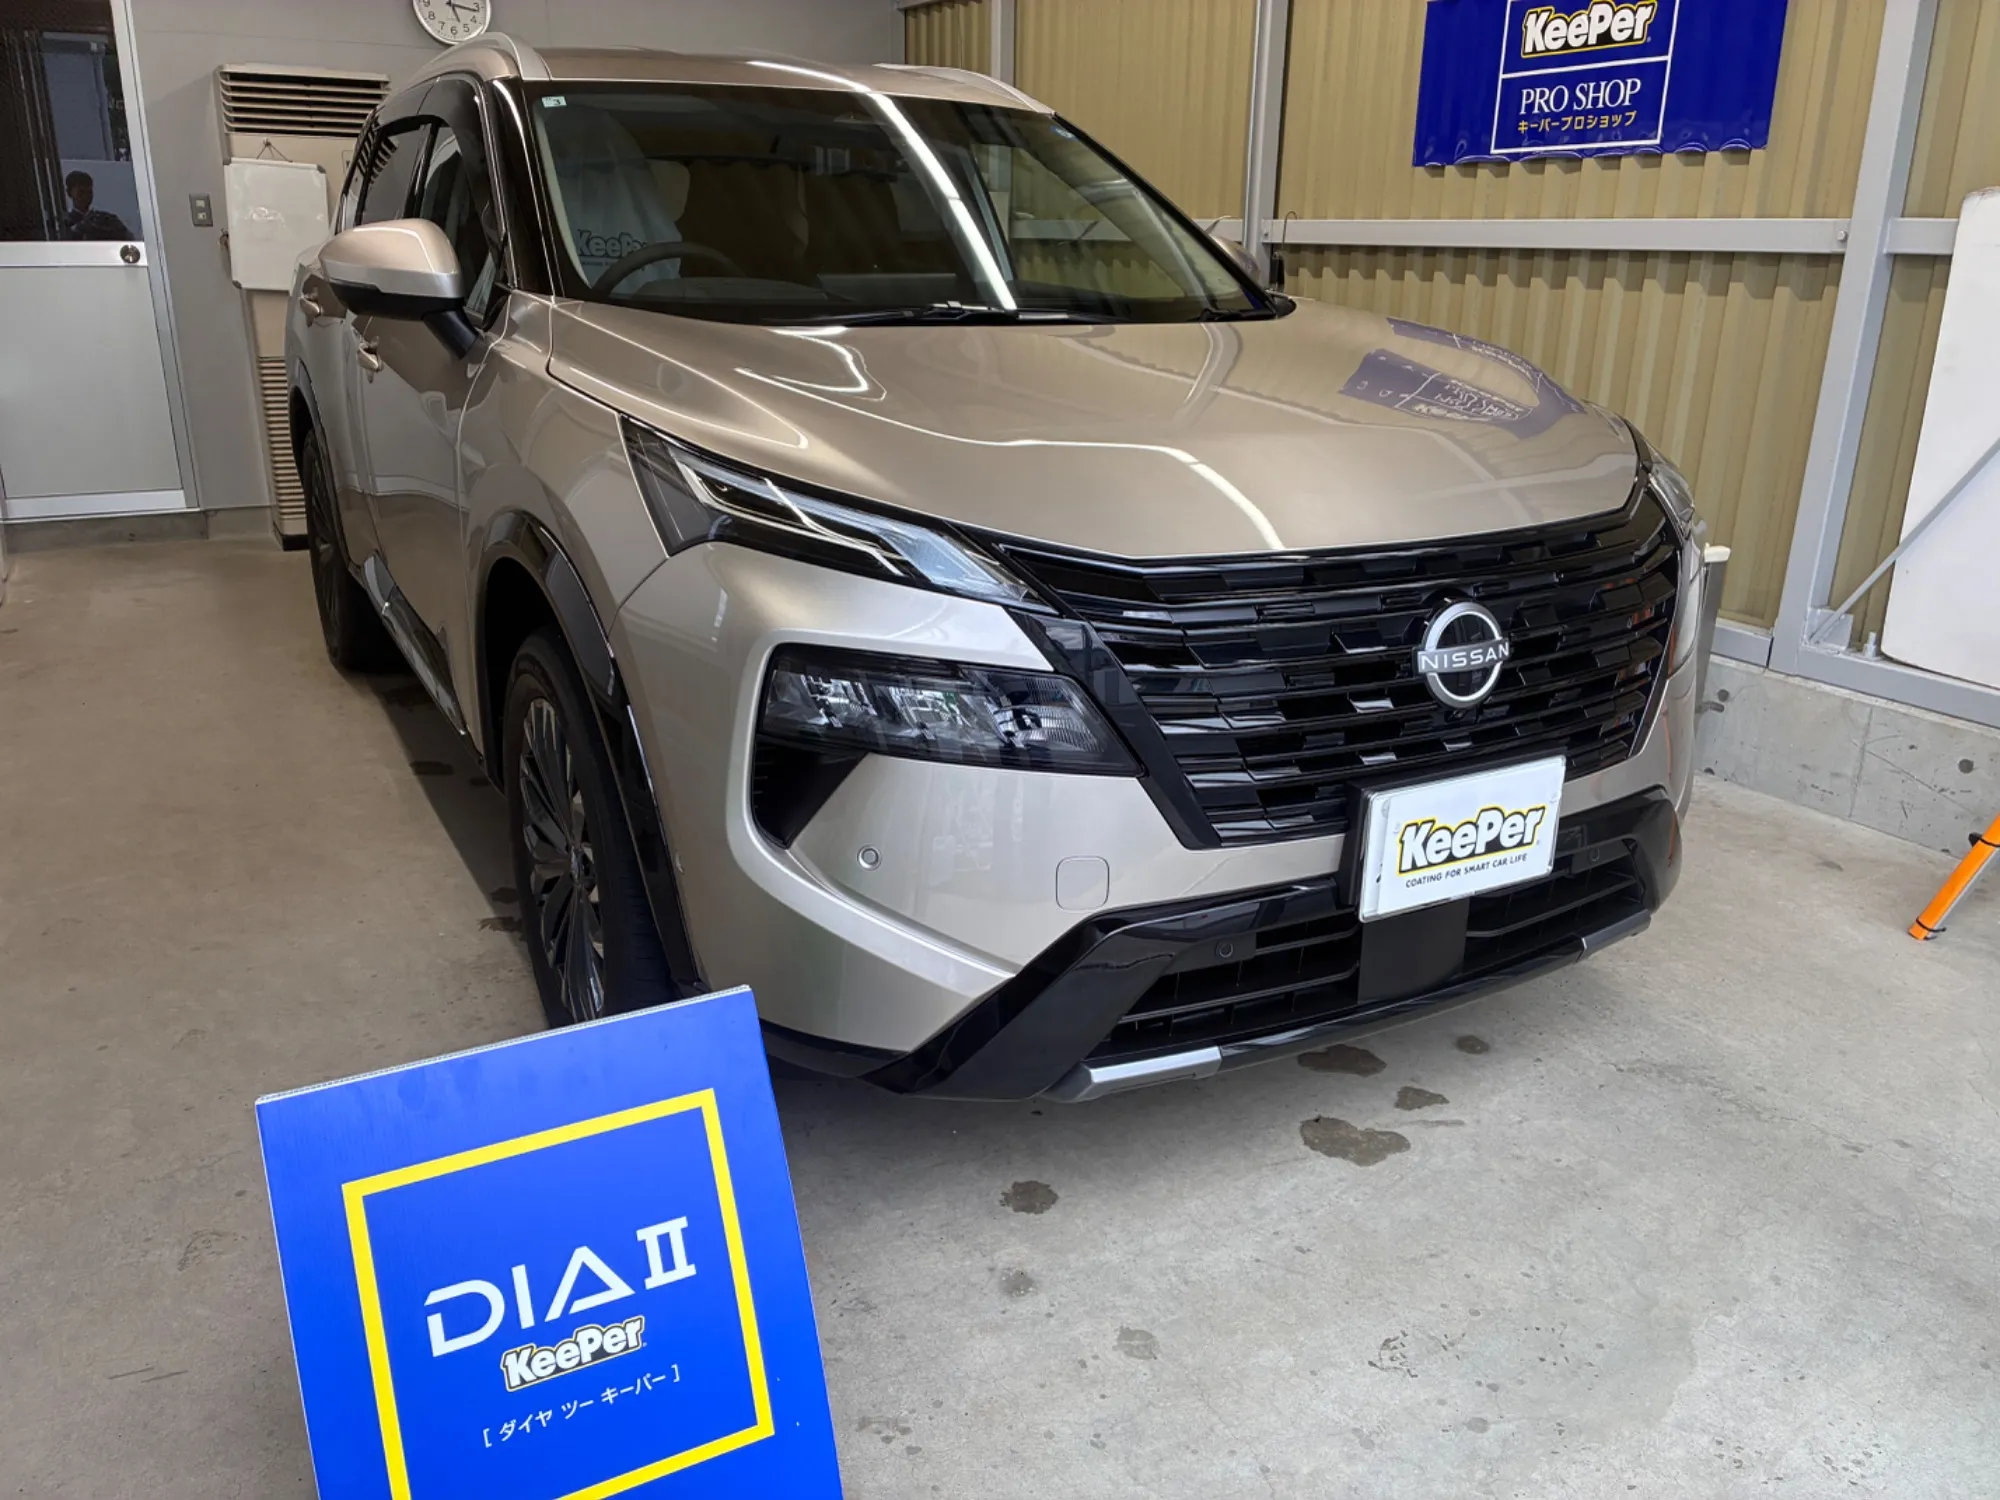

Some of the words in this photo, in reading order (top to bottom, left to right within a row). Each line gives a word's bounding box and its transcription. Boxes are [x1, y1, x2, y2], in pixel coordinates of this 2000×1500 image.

[428, 11, 436, 20] 8
[438, 21, 445, 30] 7
[450, 26, 458, 35] 6
[463, 23, 470, 32] 5
[470, 15, 477, 23] 4
[1521, 1, 1656, 58] KeePer
[1519, 84, 1569, 115] PRO
[1573, 77, 1641, 110] SHOP
[1517, 111, 1636, 133] キーパープロショップ
[1421, 641, 1509, 669] NISSAN
[1400, 806, 1546, 874] KeePer
[1405, 874, 1442, 888] COATING
[1445, 869, 1461, 880] FOR
[1464, 862, 1490, 875] SMART
[1492, 858, 1508, 869] CAR
[1510, 853, 1528, 865] LIFE
[424, 1246, 636, 1357] DIA
[503, 1317, 644, 1390] KeePer
[499, 1409, 552, 1441] ダイヤ
[561, 1399, 594, 1419] ツー
[601, 1373, 666, 1404] キーパー
